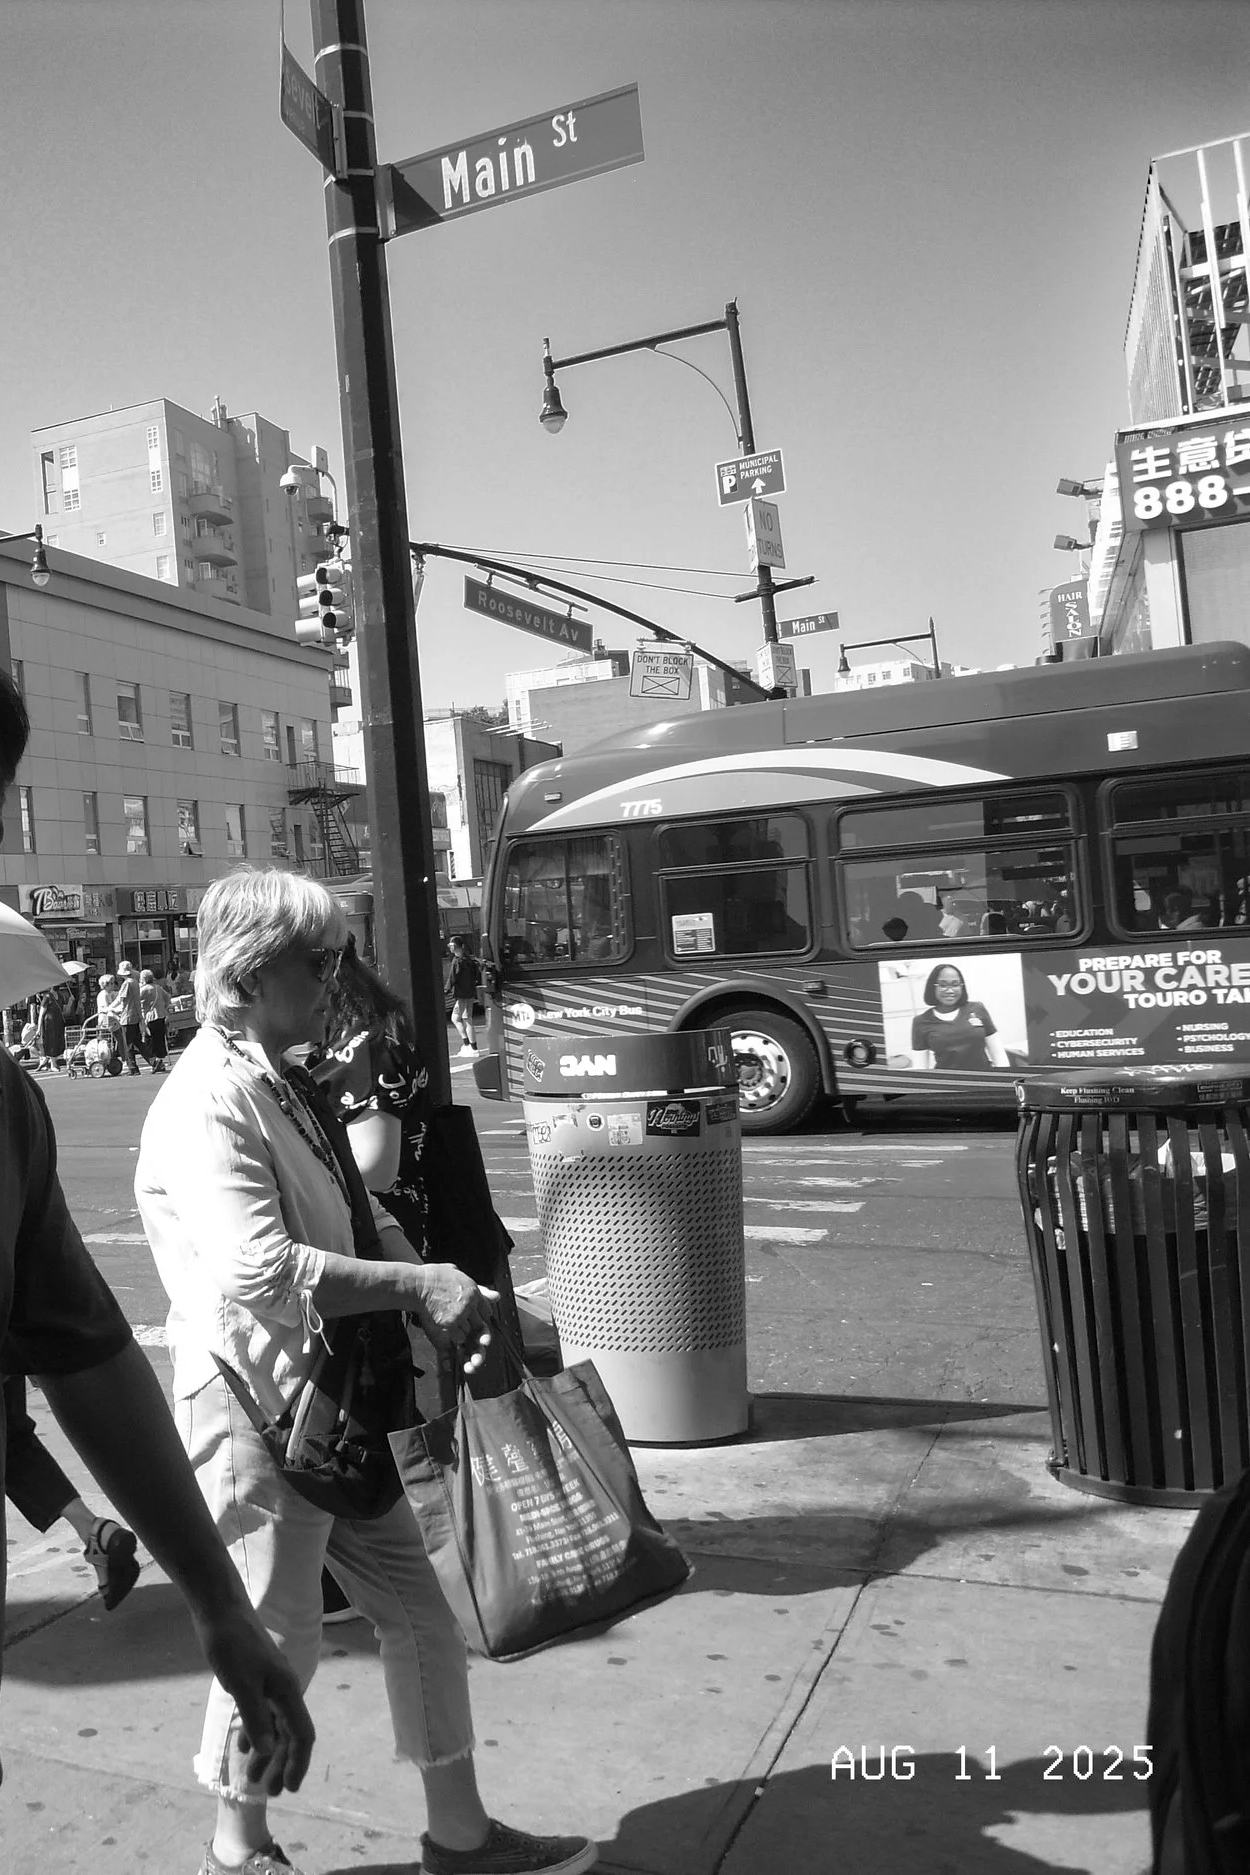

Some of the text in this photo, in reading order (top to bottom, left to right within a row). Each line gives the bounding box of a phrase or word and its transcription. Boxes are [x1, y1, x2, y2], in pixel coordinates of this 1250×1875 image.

[441, 110, 578, 209] Main St
[739, 454, 778, 470] MUNICIPAL
[740, 465, 772, 479] PARKING
[758, 510, 773, 532] NO
[757, 538, 783, 559] TURNS
[1057, 591, 1083, 603] HAIR
[478, 590, 579, 641] Roosevelt Av
[1064, 601, 1082, 637] SALON
[792, 616, 825, 634] Main St
[637, 655, 689, 666] DON'T BLOCK
[645, 666, 680, 675] THE BOX
[620, 799, 662, 818] 7775
[1079, 950, 1222, 972] PREPARE FOR
[1047, 969, 1146, 996] YOUR
[1123, 990, 1207, 1009] TOURO
[537, 1004, 643, 1020] New York City Bus
[1055, 1028, 1114, 1038] EDUCATION
[1182, 1022, 1229, 1032] NURSING
[1057, 1037, 1138, 1048] CYBERSECURITY
[1183, 1032, 1250, 1042] PSYCHOLOGY
[1057, 1048, 1145, 1059] HUMAN SERVICES
[1184, 1044, 1234, 1053] BUSINESS
[1060, 1086, 1135, 1094] Keep Flushing Clean
[1074, 1096, 1103, 1104] Flushing
[511, 1498, 533, 1512] OPEN
[534, 1496, 539, 1505] 7
